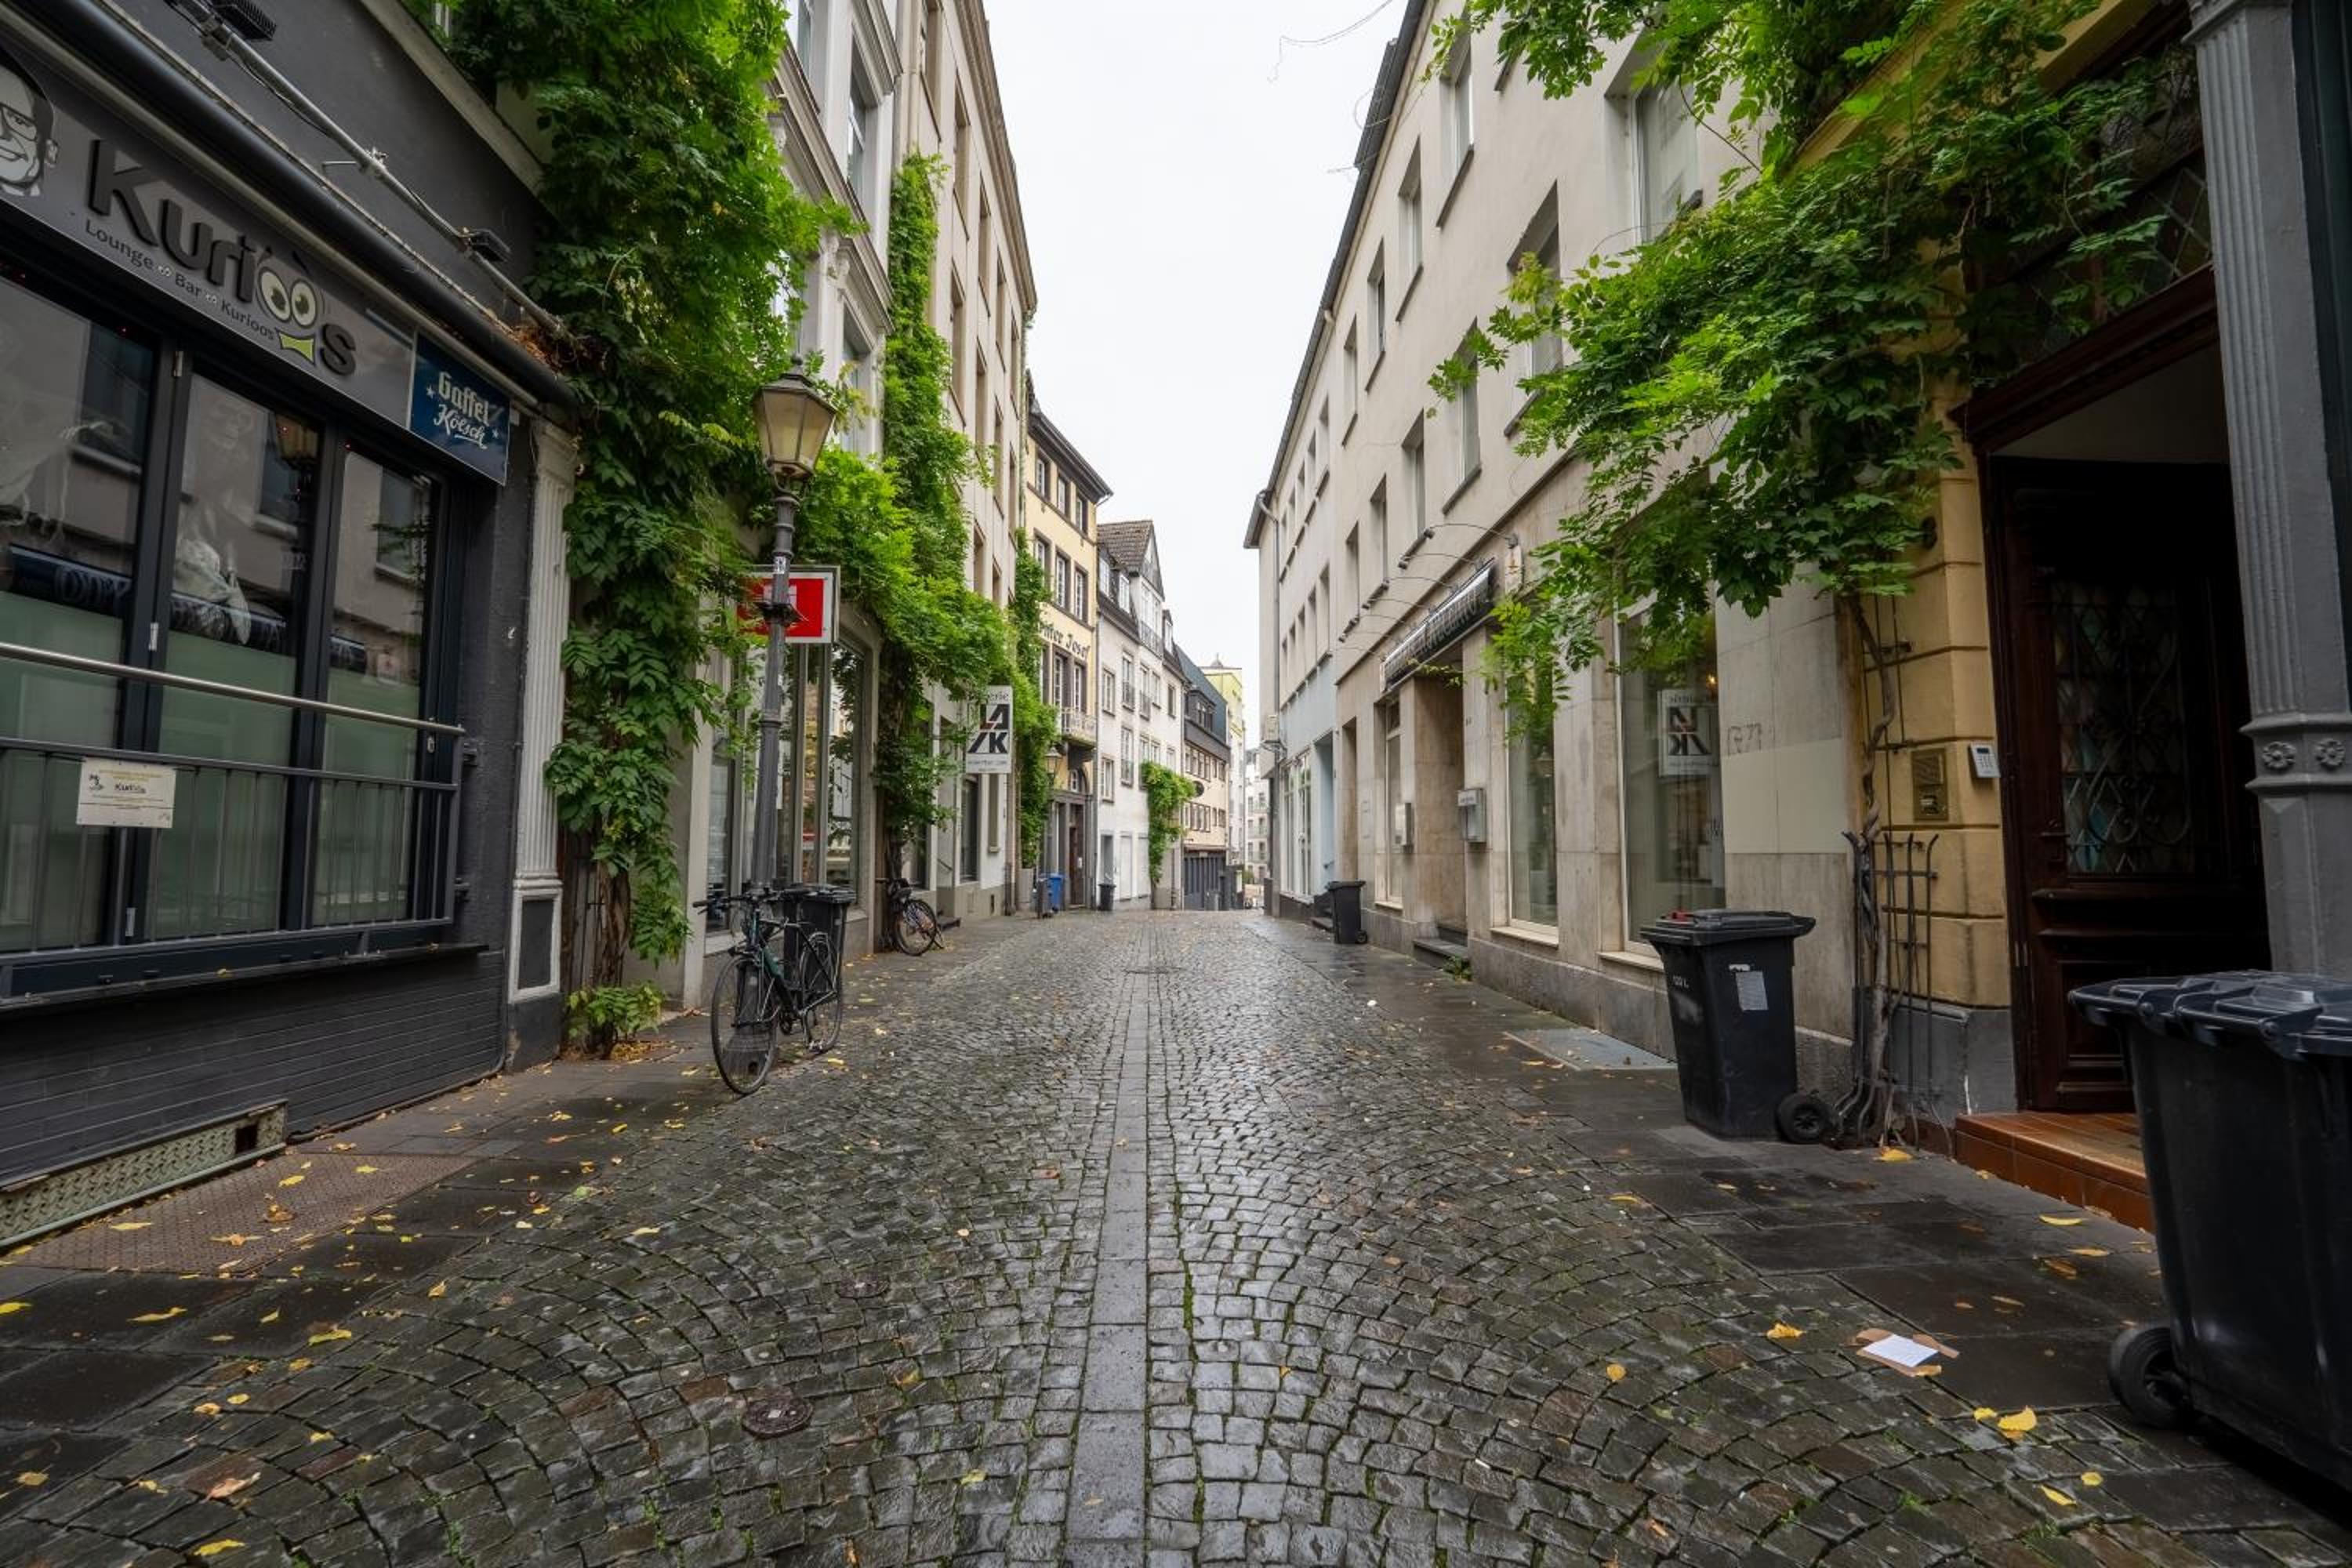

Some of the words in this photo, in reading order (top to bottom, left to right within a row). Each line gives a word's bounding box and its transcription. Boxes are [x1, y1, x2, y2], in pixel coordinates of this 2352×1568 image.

[85, 219, 154, 269] Lounge
[174, 271, 202, 297] Bar
[433, 404, 488, 450] Kölsch
[438, 371, 490, 427] Gaffel
